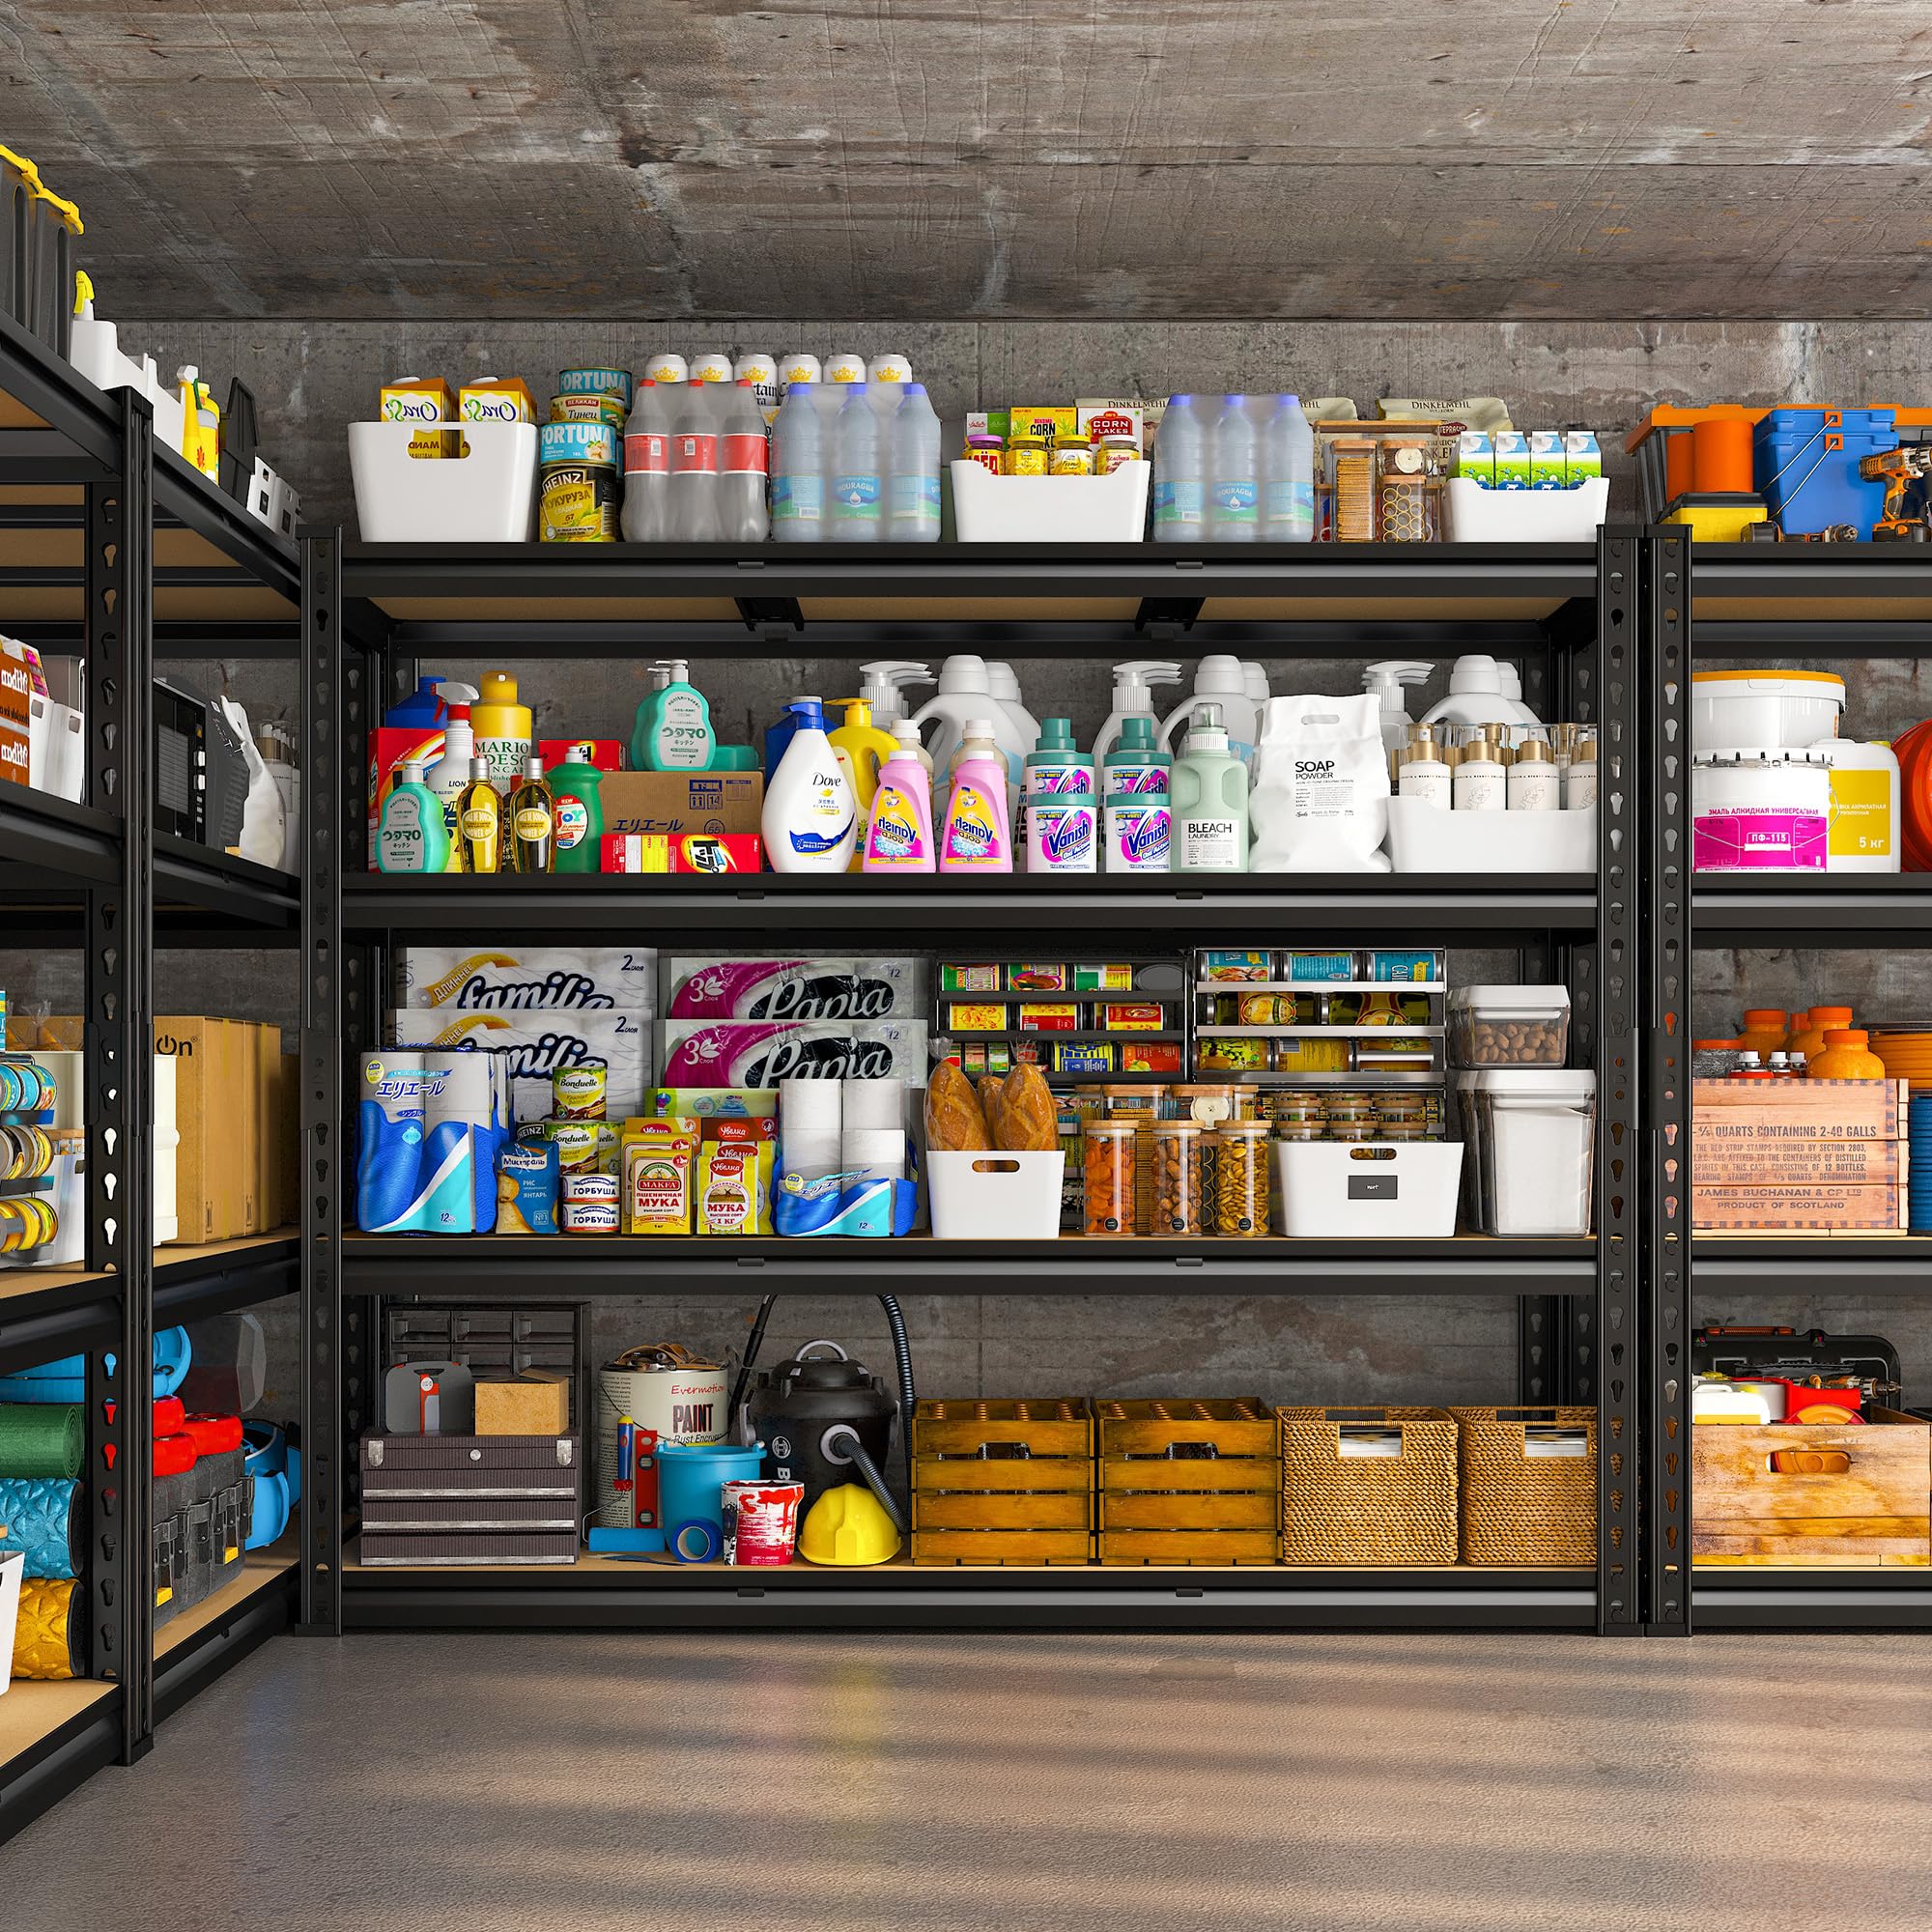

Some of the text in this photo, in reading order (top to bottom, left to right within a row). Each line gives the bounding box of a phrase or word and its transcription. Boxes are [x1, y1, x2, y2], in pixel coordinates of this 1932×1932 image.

[561, 372, 627, 391] FORTUNA
[568, 410, 597, 421] Тунец
[541, 425, 611, 445] FORTUNA
[1030, 423, 1056, 436] CORN
[545, 472, 582, 494] HEINZ
[545, 490, 591, 510] КУКУРУЗА
[662, 726, 706, 739] ウタマロ
[475, 741, 528, 753] MARIO
[1295, 760, 1335, 772] SOAP
[812, 772, 841, 786] Dove
[612, 819, 684, 834] エリエール
[1188, 823, 1232, 833] BLEACH
[383, 830, 421, 841] ウタマロ
[1048, 819, 1089, 855] Vanish
[1127, 819, 1167, 855] Vanish
[1751, 834, 1786, 842] ПФ-115
[1859, 837, 1885, 848] 5 кг
[621, 954, 633, 971] 2
[889, 968, 900, 978] 12
[1391, 964, 1411, 981] САЙ
[434, 963, 473, 1003] ДЛИННЕЕ
[689, 977, 704, 1003] 3
[614, 1016, 626, 1034] 2
[888, 1030, 899, 1040] 12
[684, 1040, 699, 1065] 3
[560, 1079, 598, 1089] Bonduelle
[376, 1080, 446, 1101] エリエール
[518, 1126, 542, 1139] HEINZ
[720, 1126, 746, 1136] Увелка
[1716, 1126, 1876, 1137] QUARTS CONTAINING 2-40 GALLS
[553, 1134, 590, 1144] Bonduelle
[599, 1134, 615, 1143] uelle
[1696, 1144, 1707, 1152] THE
[1725, 1144, 1744, 1152] STRIP
[1747, 1144, 1772, 1152] STAMPS
[1776, 1144, 1804, 1152] REQUIRED
[1808, 1144, 1816, 1152] BY
[1819, 1144, 1845, 1152] SECTION
[1768, 1153, 1779, 1162] THE
[1782, 1153, 1822, 1162] CONTAINERS
[1824, 1153, 1832, 1162] OF
[1835, 1153, 1866, 1162] DISTILLED
[1693, 1163, 1719, 1172] SPIRITS
[1772, 1163, 1808, 1172] CONSISTING
[1812, 1163, 1820, 1172] OF
[1825, 1163, 1832, 1172] 12
[1693, 1173, 1720, 1181] BEARING
[1727, 1173, 1752, 1181] STAMPS
[1787, 1173, 1812, 1181] QUARTS
[1819, 1173, 1866, 1181] DENOMINATION
[639, 1198, 680, 1207] МУКА
[707, 1204, 745, 1212] МУКА
[440, 1213, 449, 1222] 12
[672, 1404, 714, 1433] PAINT
